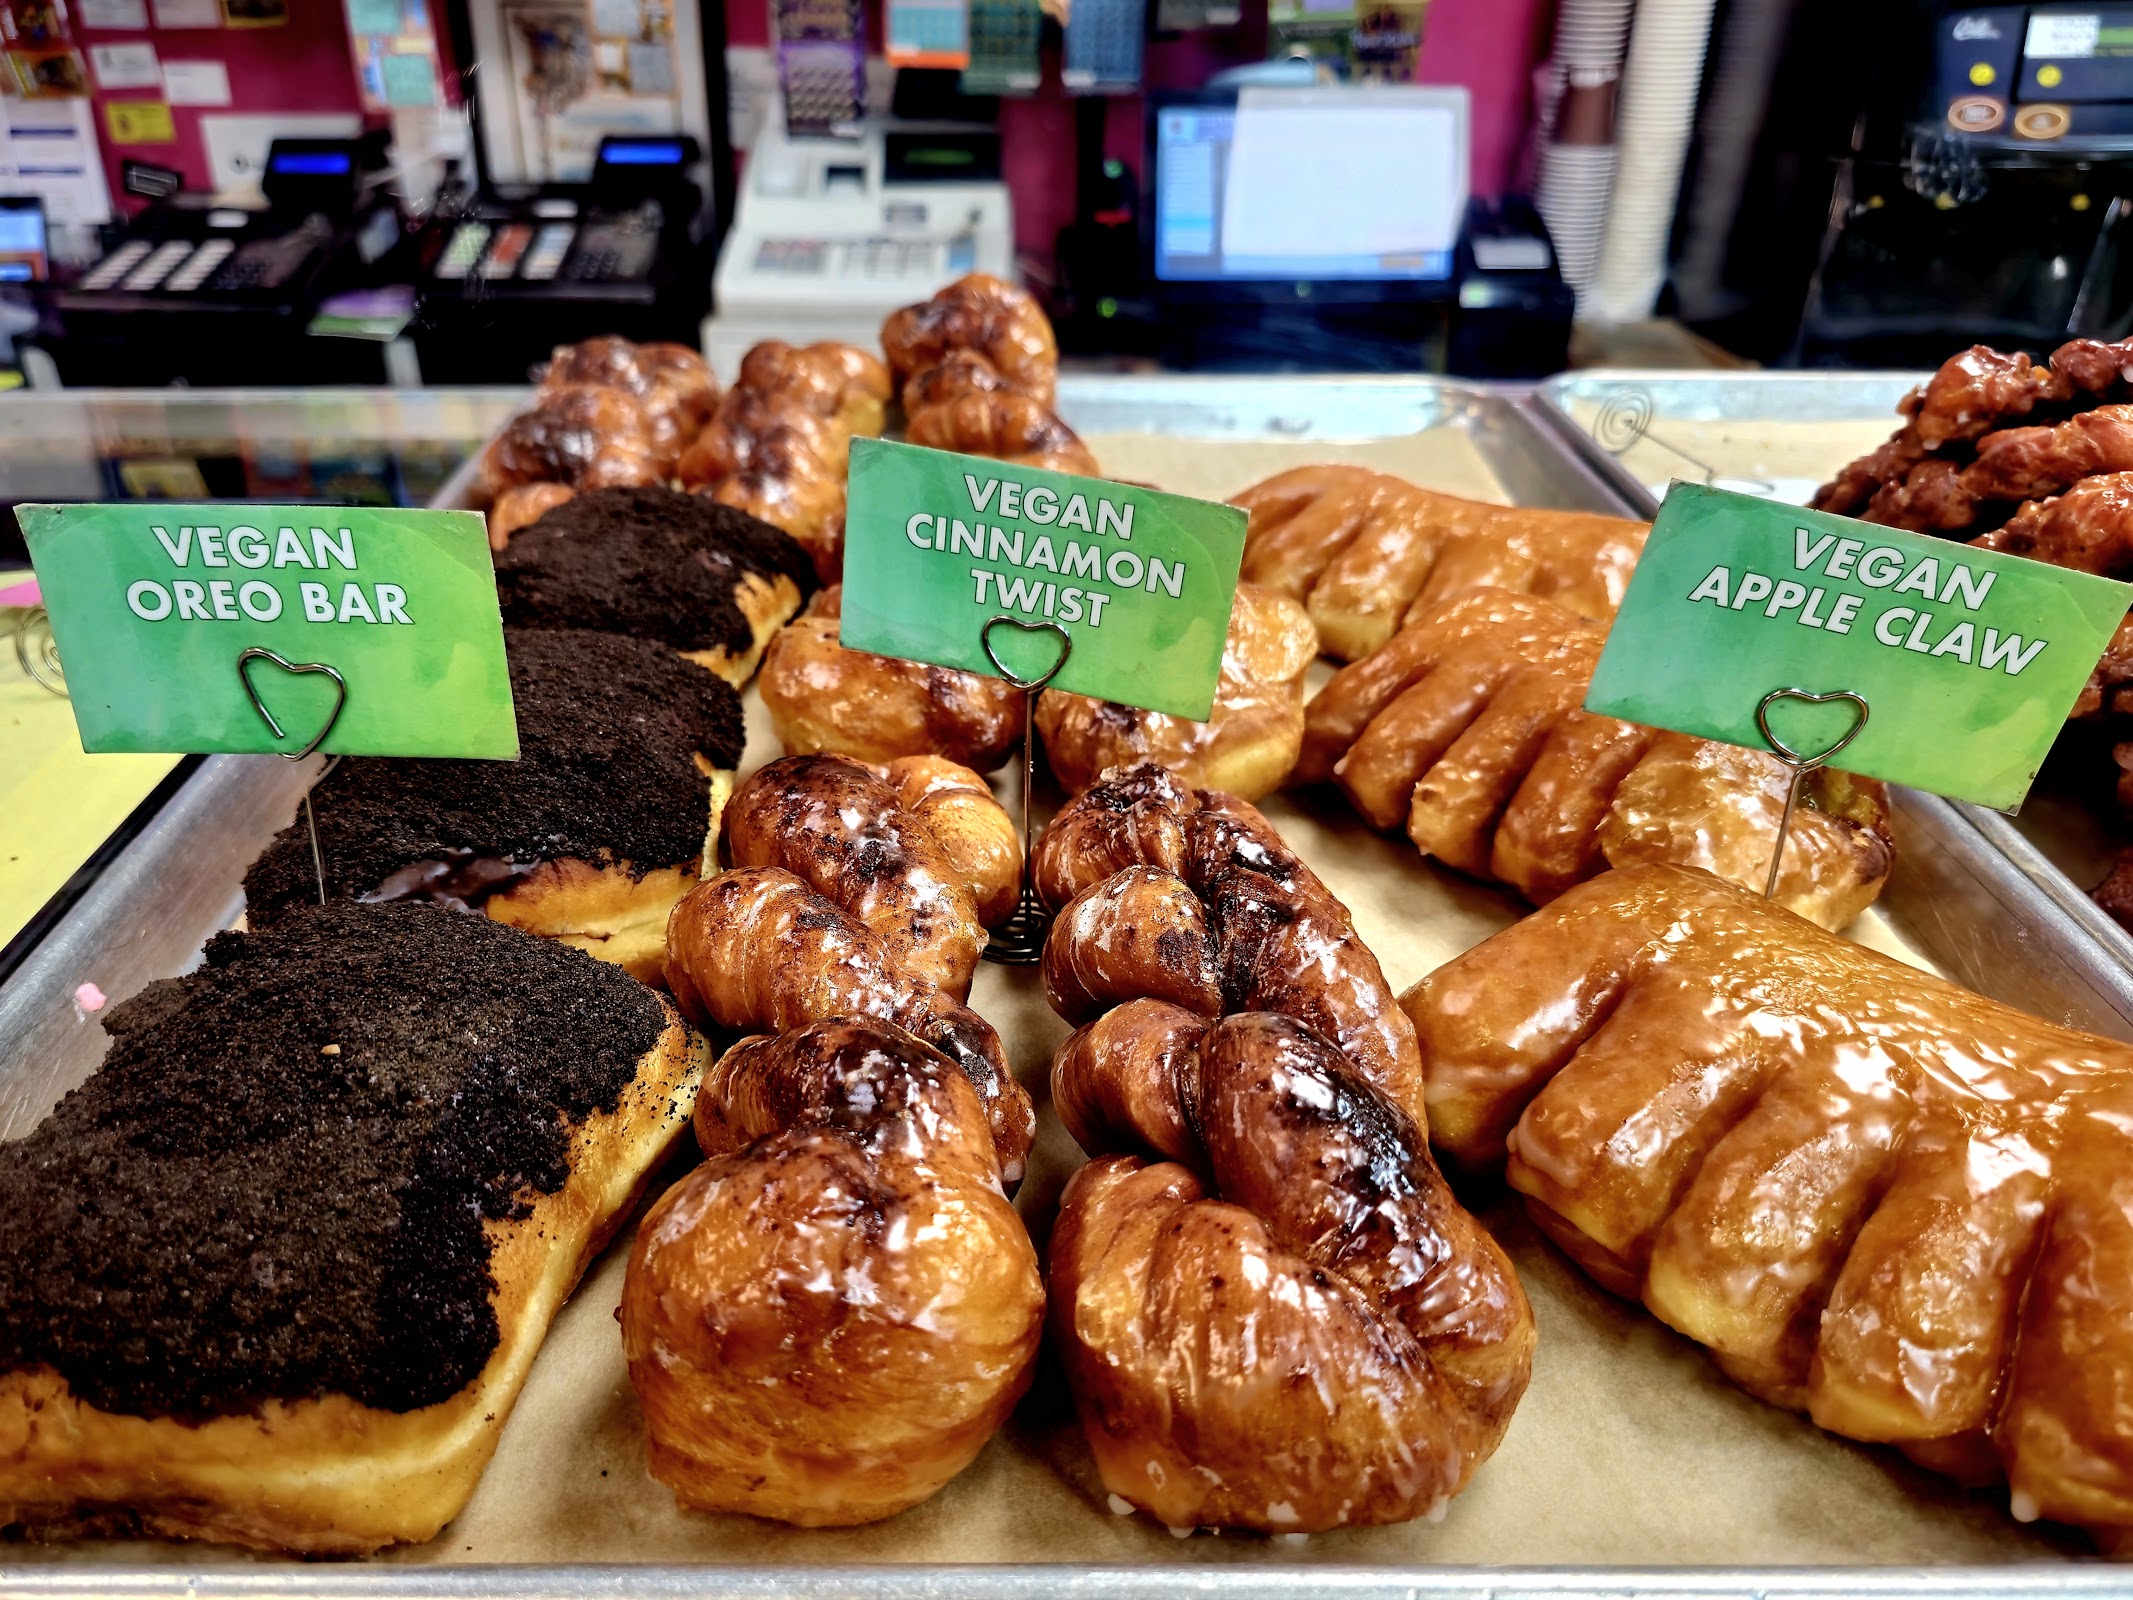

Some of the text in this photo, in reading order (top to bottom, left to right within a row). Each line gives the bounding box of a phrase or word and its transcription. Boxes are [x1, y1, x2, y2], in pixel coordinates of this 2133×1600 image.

[963, 474, 1136, 541] VEGAN
[151, 525, 359, 570] VEGAN
[905, 513, 1187, 599] CINNAMON
[1794, 527, 1999, 612] VEGAN
[126, 579, 416, 625] OREO BAR
[970, 568, 1111, 628] TWIST
[1687, 565, 2050, 677] APPLE CLAW
